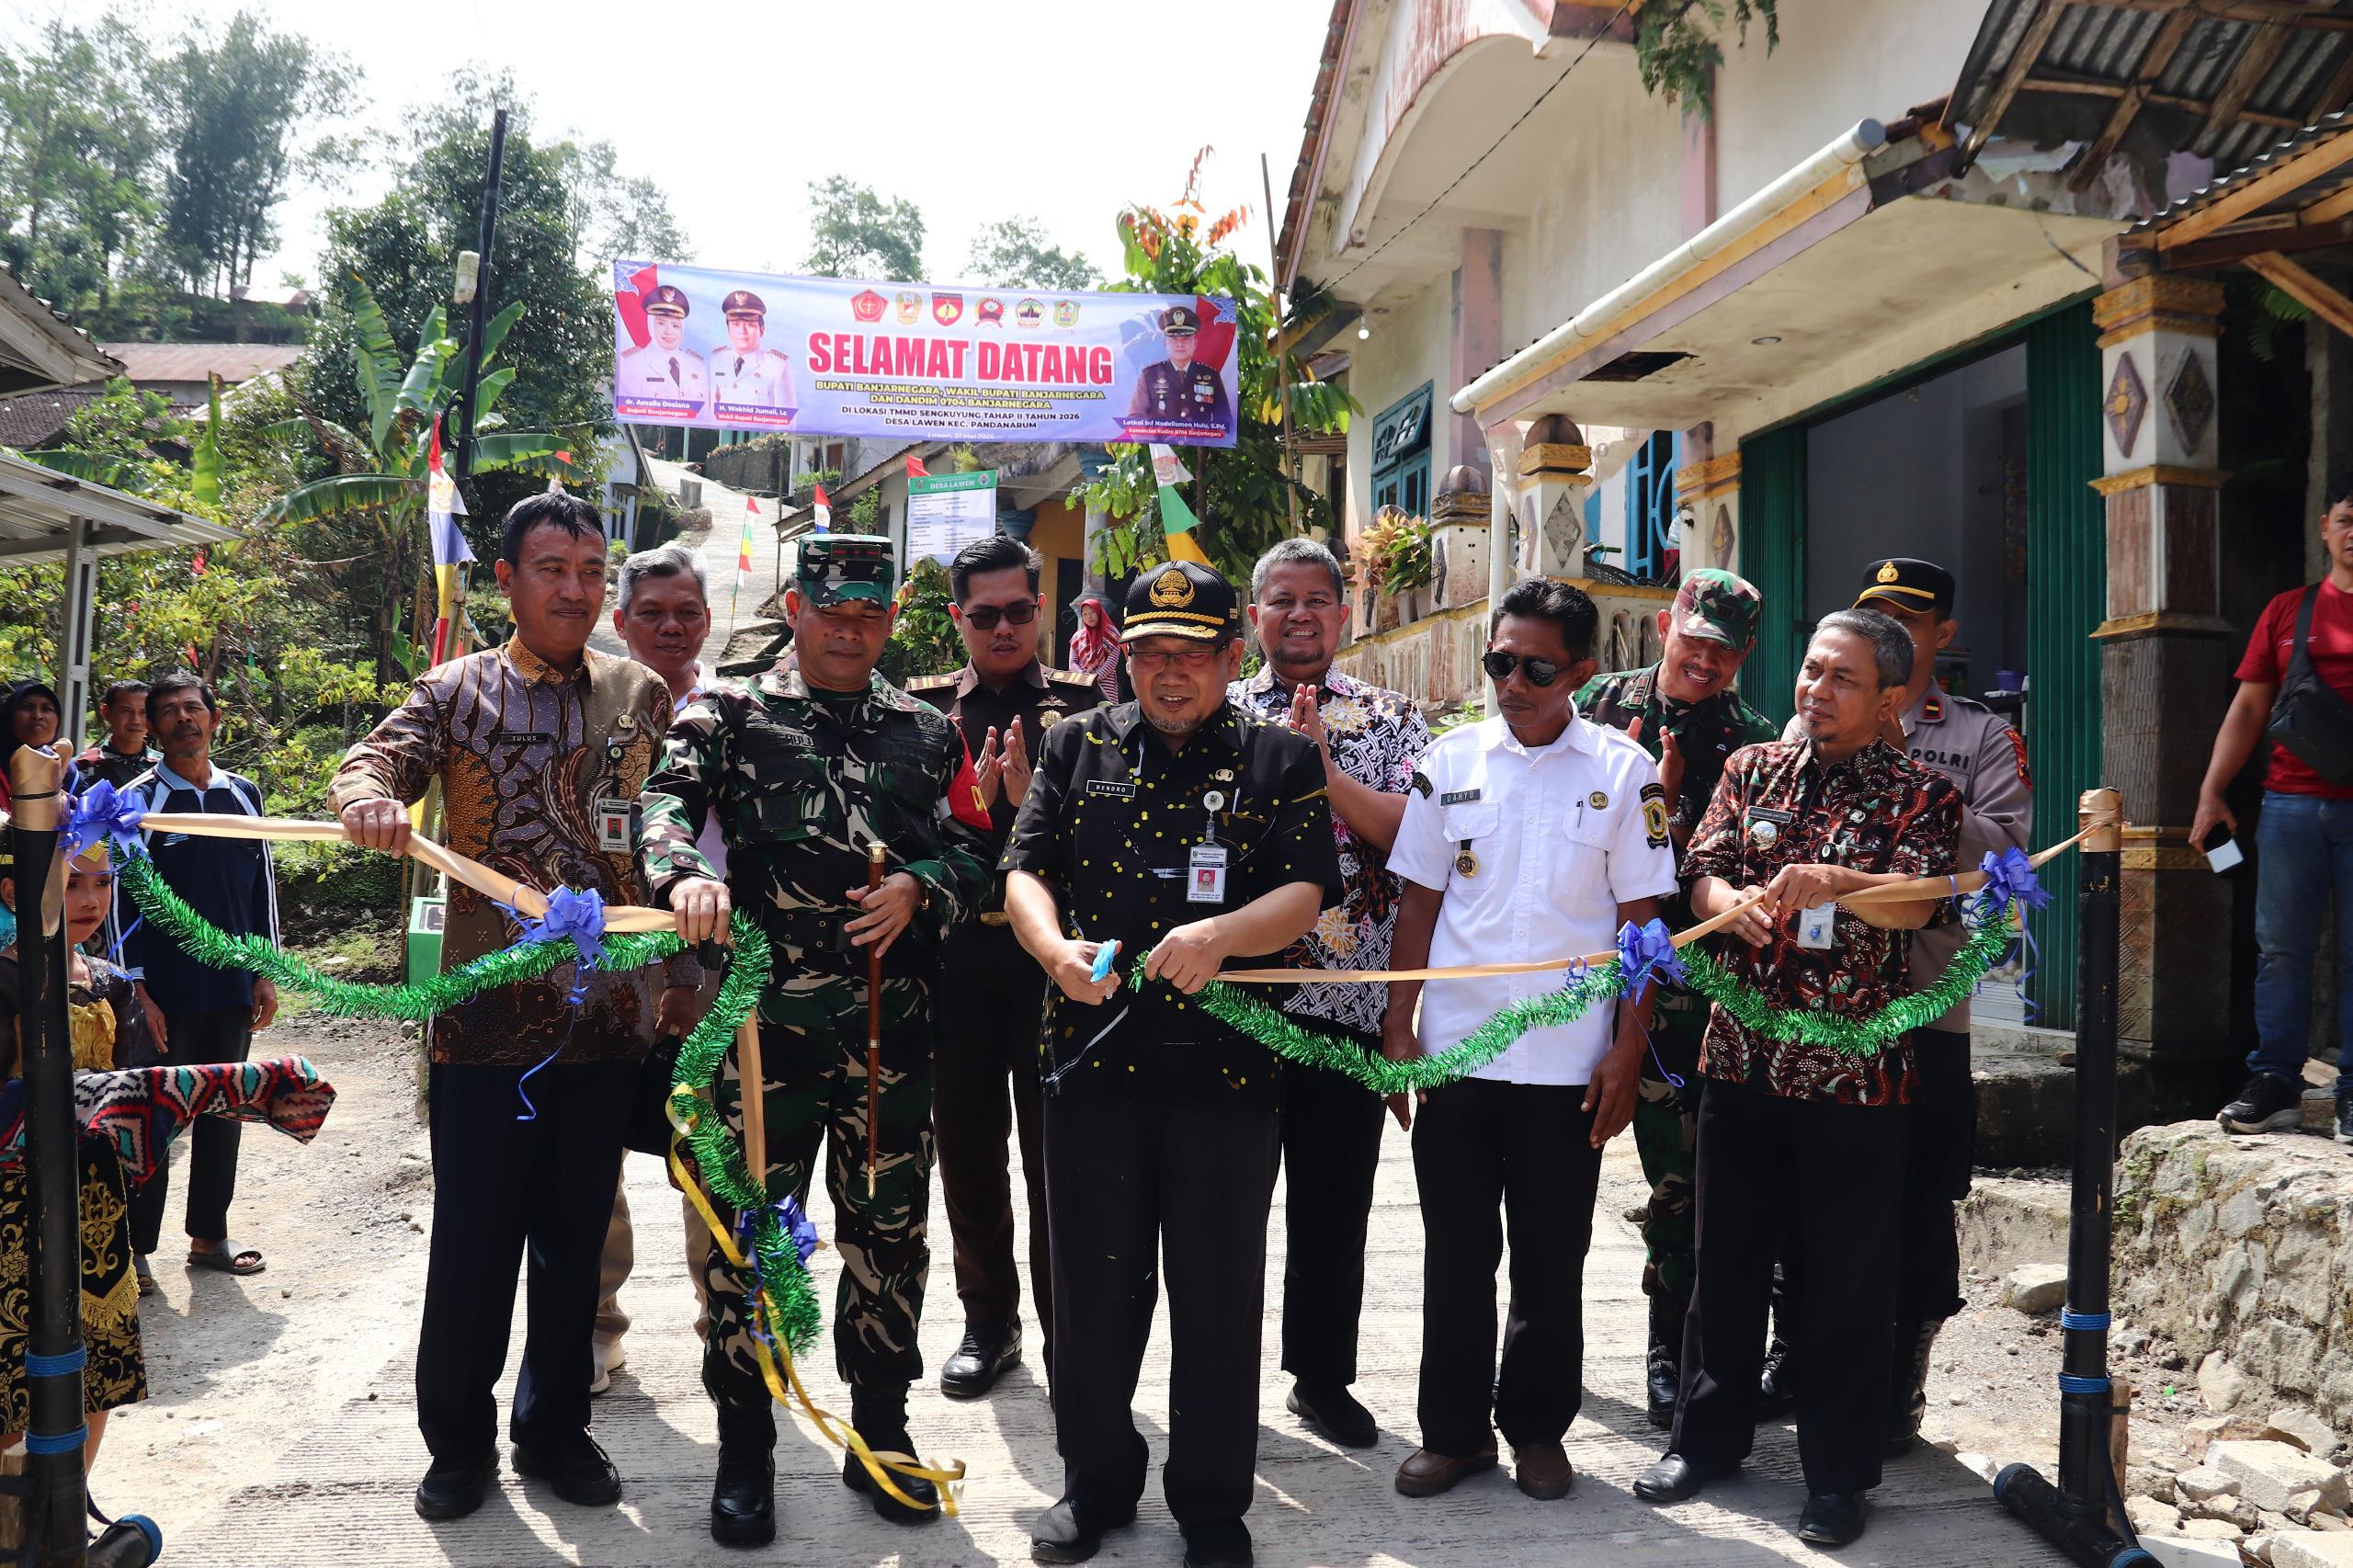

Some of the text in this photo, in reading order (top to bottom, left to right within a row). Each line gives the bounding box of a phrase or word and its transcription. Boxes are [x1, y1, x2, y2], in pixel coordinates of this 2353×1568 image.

[808, 332, 1113, 385] SELAMAT DATANG
[816, 381, 1106, 400] BUPATI BANJARNEGARA, WAKIL BUPATI BANJARNEGARA
[636, 399, 661, 407] Amalia
[663, 401, 690, 409] Desiana
[870, 394, 1052, 410] DAN DANDIM 0704 BANJARNEGARA
[647, 408, 688, 416] Banjarnegara
[854, 406, 887, 415] LOKASI
[889, 407, 917, 416] TMMD
[919, 409, 982, 420] SENGKUYUNG
[983, 412, 1014, 420] TAHAP
[885, 417, 909, 426] DESA
[912, 418, 946, 426] LAWEN
[971, 421, 1037, 429] PANDANARUM
[930, 480, 974, 490] DESA LAWEN
[1911, 748, 1970, 769] POLRI
[1096, 784, 1126, 793] HENDRO
[1447, 790, 1474, 803] DAHYO
